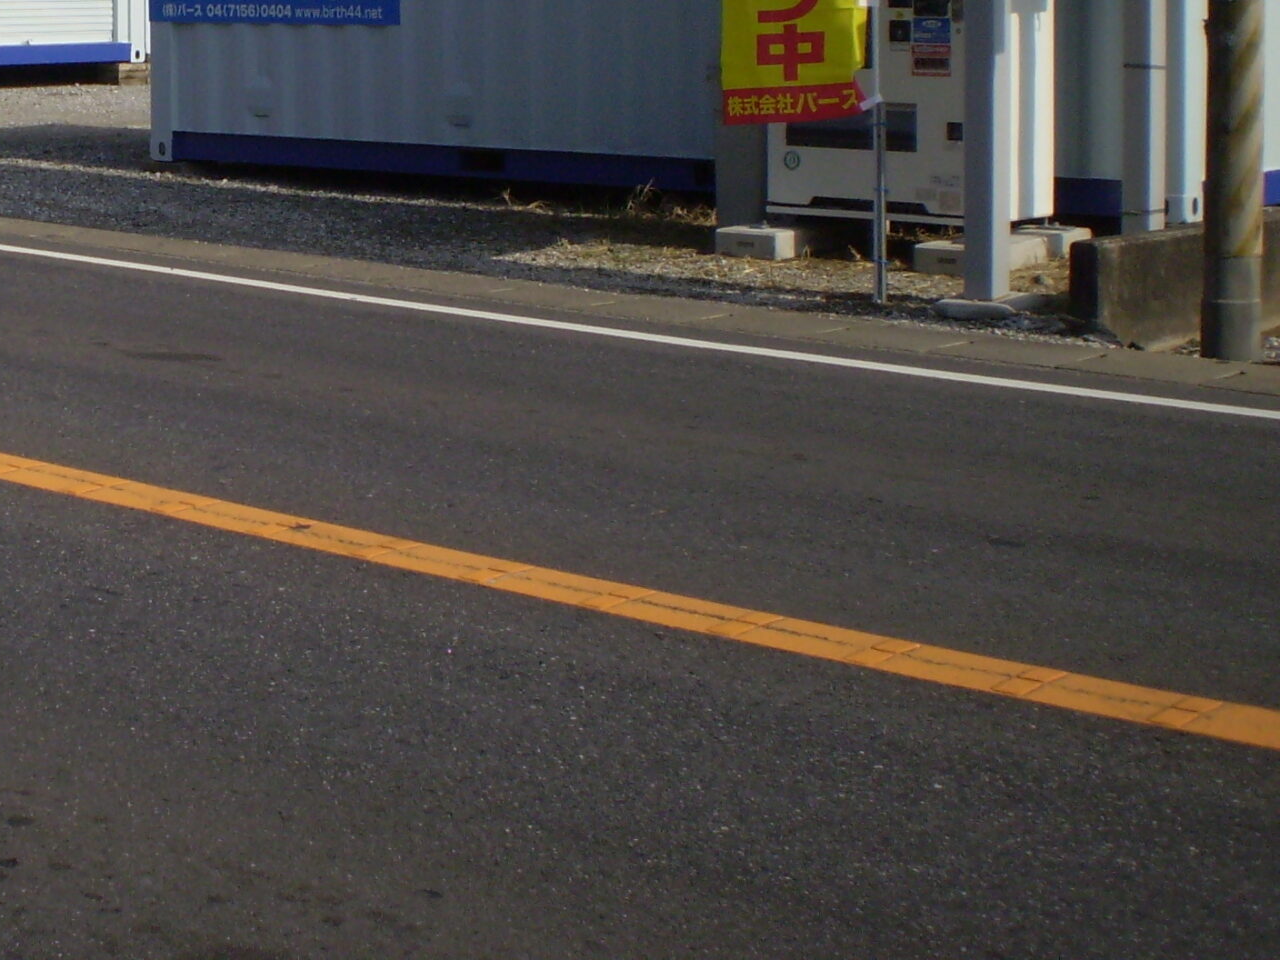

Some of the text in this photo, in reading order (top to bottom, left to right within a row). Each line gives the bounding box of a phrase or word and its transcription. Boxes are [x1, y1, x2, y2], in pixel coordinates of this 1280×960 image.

[206, 4, 292, 18] 04(7156)0404
[294, 4, 383, 19] www.birth44.net
[728, 89, 858, 117] 株式会社バース
